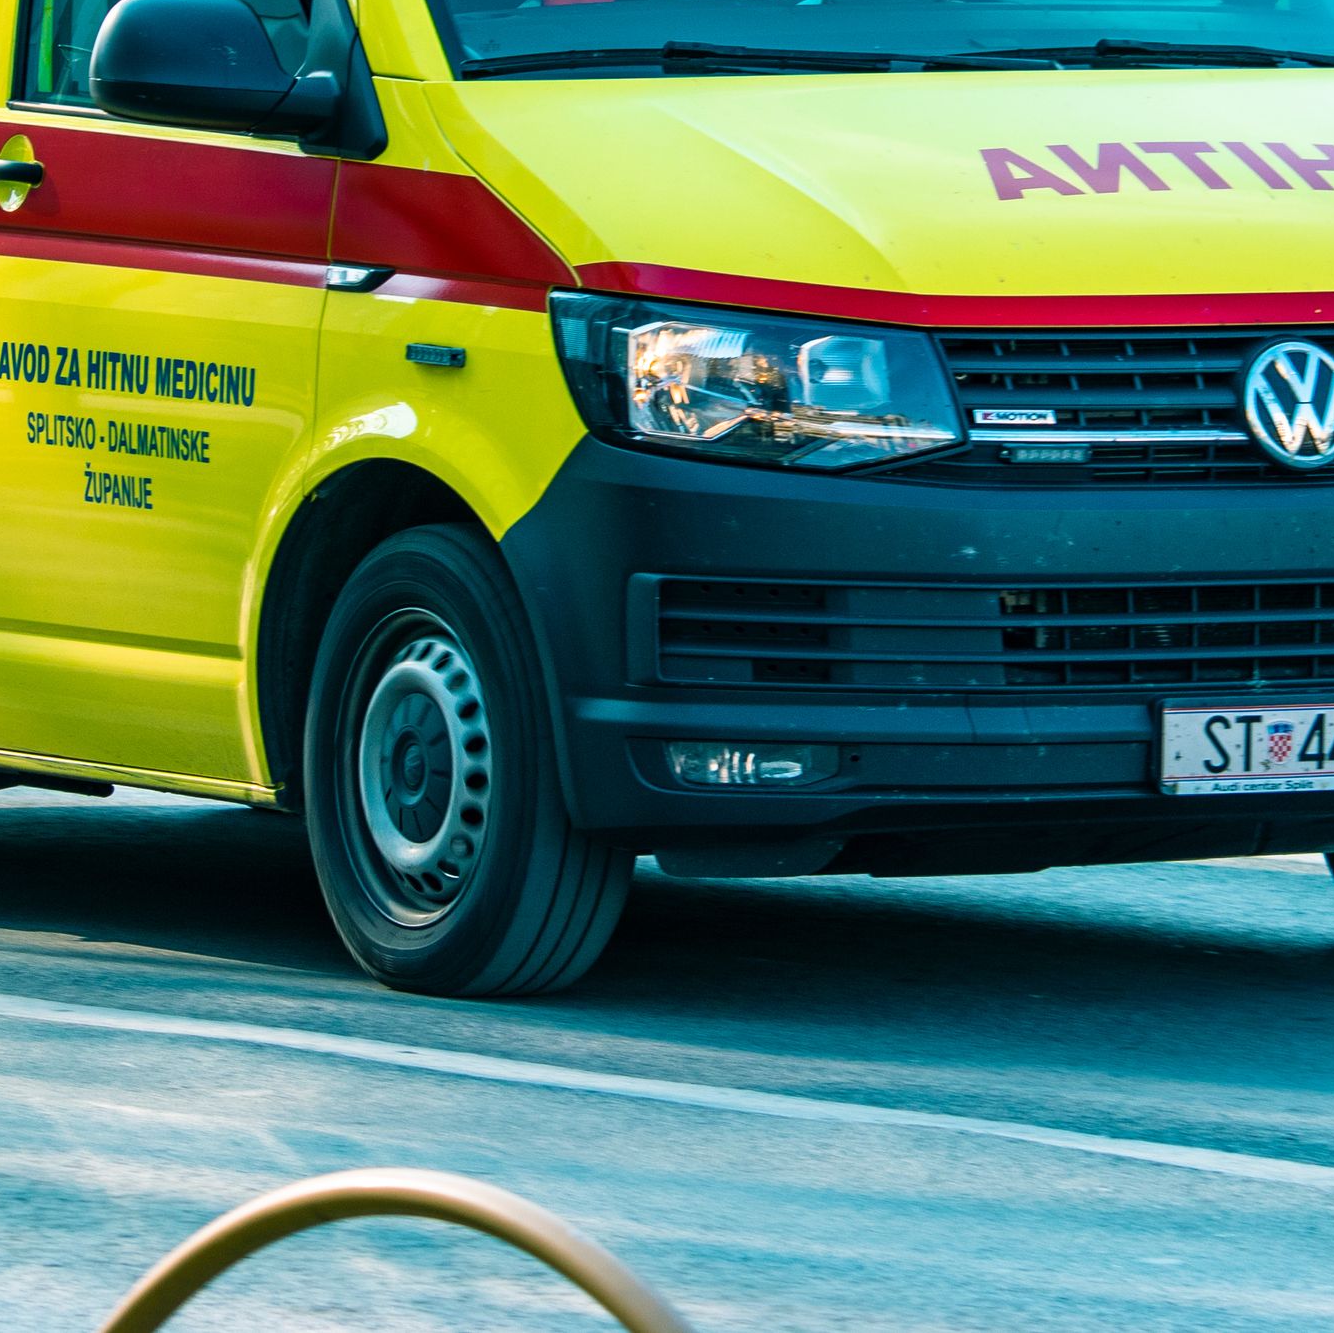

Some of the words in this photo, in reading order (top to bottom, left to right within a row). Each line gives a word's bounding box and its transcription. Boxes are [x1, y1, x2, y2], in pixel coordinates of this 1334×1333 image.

[54, 346, 81, 388] ZA
[86, 349, 150, 395] HITNU
[154, 356, 257, 407] MEDICINU
[27, 411, 96, 451] SPLITSKO
[107, 420, 211, 464] DALMATINSKE
[83, 461, 154, 510] ŽUPANIJE
[1202, 714, 1264, 774] ST
[1211, 781, 1238, 792] Audi
